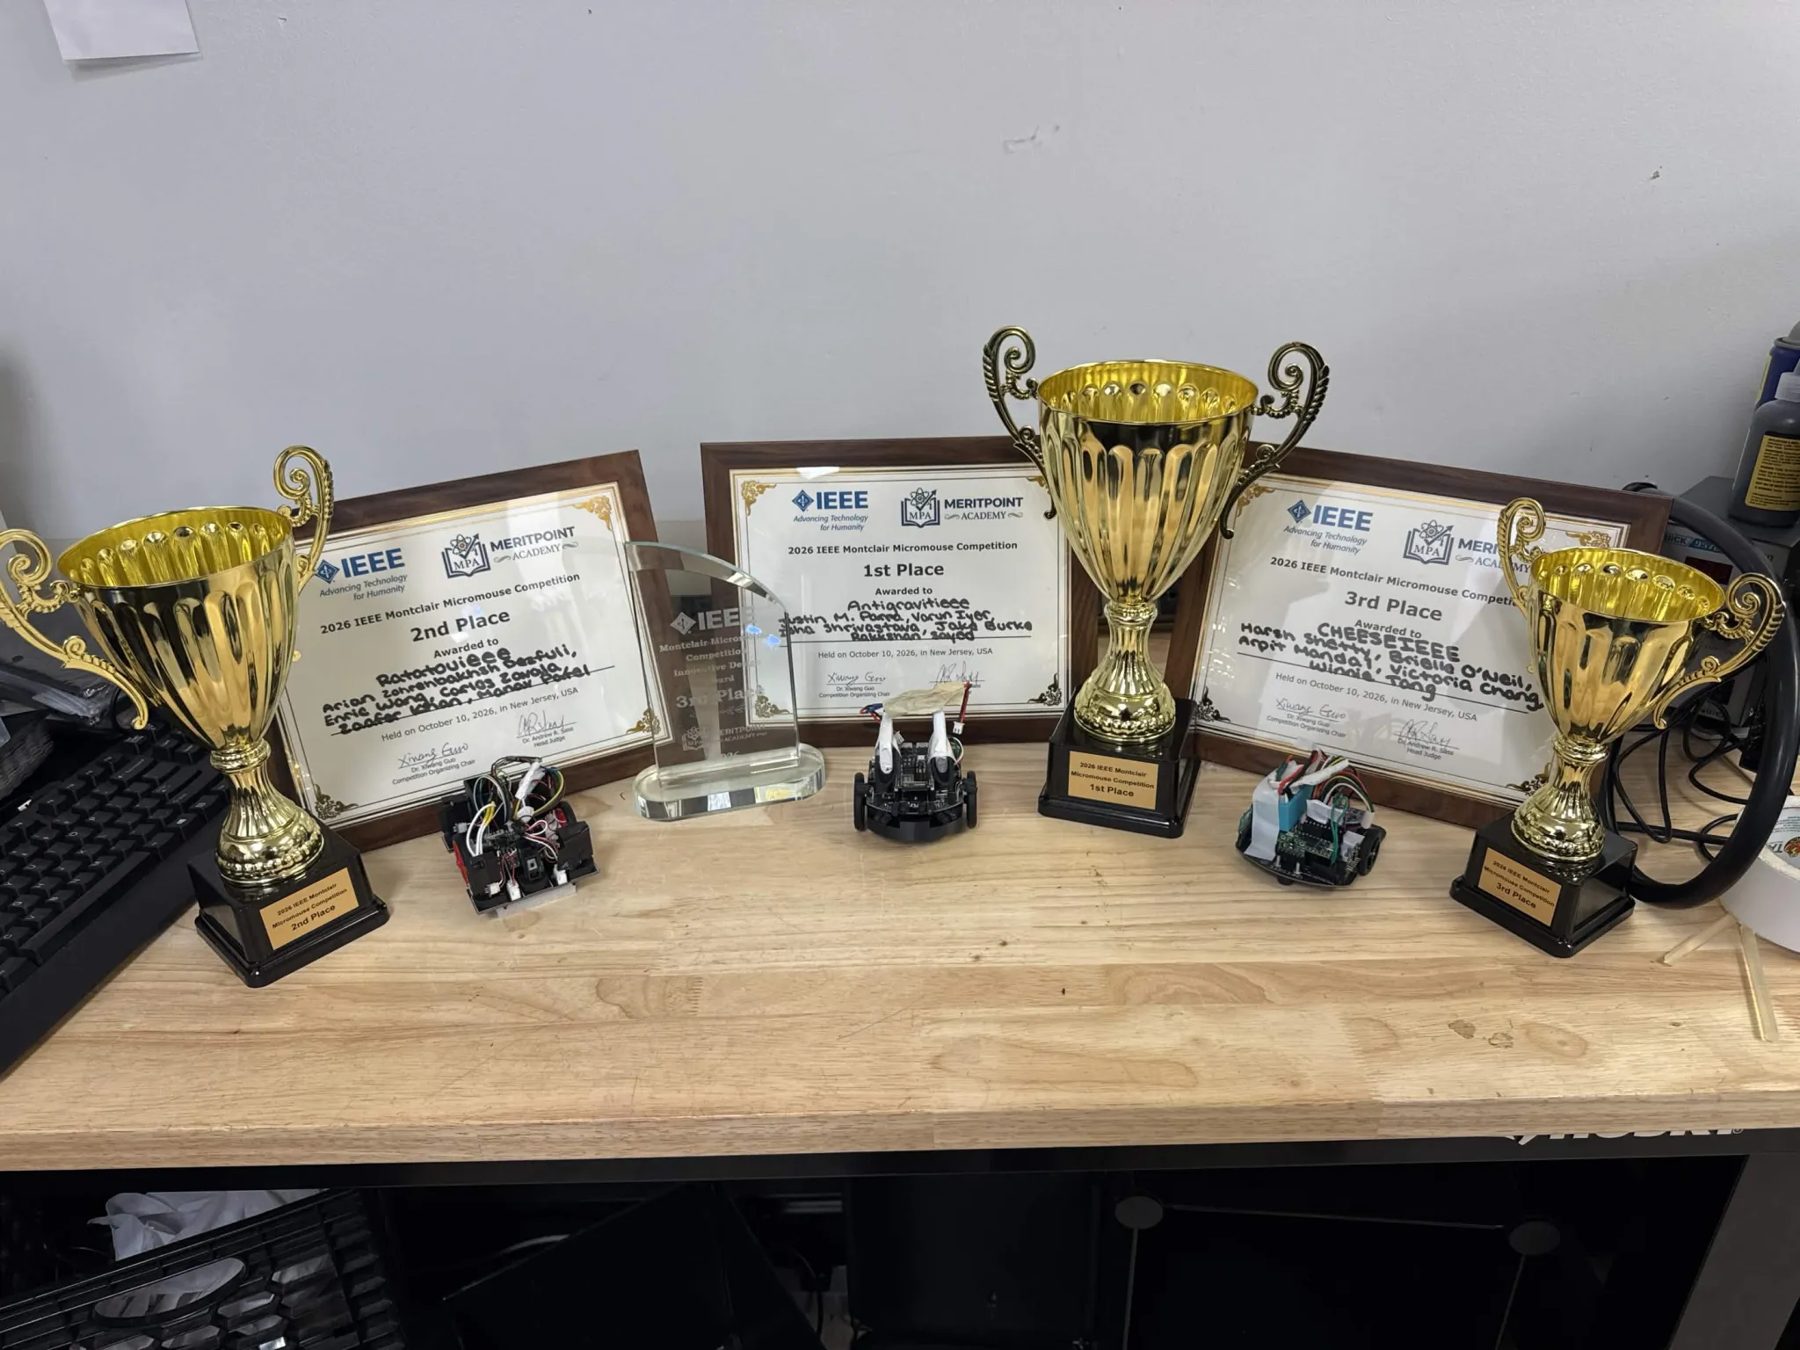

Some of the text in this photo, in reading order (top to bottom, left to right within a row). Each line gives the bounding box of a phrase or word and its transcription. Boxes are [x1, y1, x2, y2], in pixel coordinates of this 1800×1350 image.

[816, 491, 868, 510] IEEE
[944, 497, 1024, 509] MERITPOINT
[831, 514, 868, 523] Technology
[909, 512, 932, 520] MPA
[961, 511, 1006, 520] ACADEMY
[1312, 504, 1374, 532] IEEE
[490, 526, 576, 552] MERITPOINT
[1284, 526, 1368, 545] Advancing Technology
[512, 544, 561, 560] ACADEMY
[788, 541, 1018, 554] 2026 IEEE Montclair Micromouse Competition
[1310, 539, 1360, 555] for Humanity
[1414, 544, 1440, 556] MPA
[341, 548, 405, 578] IEEE
[454, 558, 480, 570] MPA
[864, 563, 944, 577] 1st Place
[1475, 558, 1530, 574] ACAMY
[1270, 556, 1298, 568] 2026
[1300, 562, 1327, 574] IEEE
[1330, 567, 1384, 583] Montclair
[1386, 576, 1458, 596] Micromouse
[320, 574, 408, 597] Advancing Technology
[354, 585, 405, 600] for Humanity
[875, 587, 920, 596] Awarded
[320, 574, 580, 634] 2026 IEEE Montclair Micromouse Competition
[1344, 591, 1442, 620] 3rd Place
[410, 611, 510, 642] 2nd Place
[1354, 620, 1422, 638] Awarded to
[434, 638, 499, 658] Awarded to
[882, 650, 894, 658] 10,
[896, 650, 918, 658] 2026,
[948, 648, 974, 657] Jersey,
[1276, 672, 1294, 683] Held
[1310, 680, 1344, 693] October
[1346, 688, 1360, 698] 10,
[1362, 690, 1388, 704] 2026,
[1402, 700, 1420, 710] New
[1424, 704, 1454, 718] Jersey,
[1458, 712, 1477, 722] USA
[382, 731, 402, 742] Held
[418, 718, 453, 732] October
[456, 714, 470, 724] 10,
[472, 708, 497, 719] 2026,
[510, 700, 528, 710] New
[531, 693, 558, 705] Jersey,
[561, 688, 578, 697] USA
[1090, 784, 1134, 797] 1st Place
[1496, 882, 1536, 908] 3rd Place
[291, 905, 336, 931] 2nd Place
